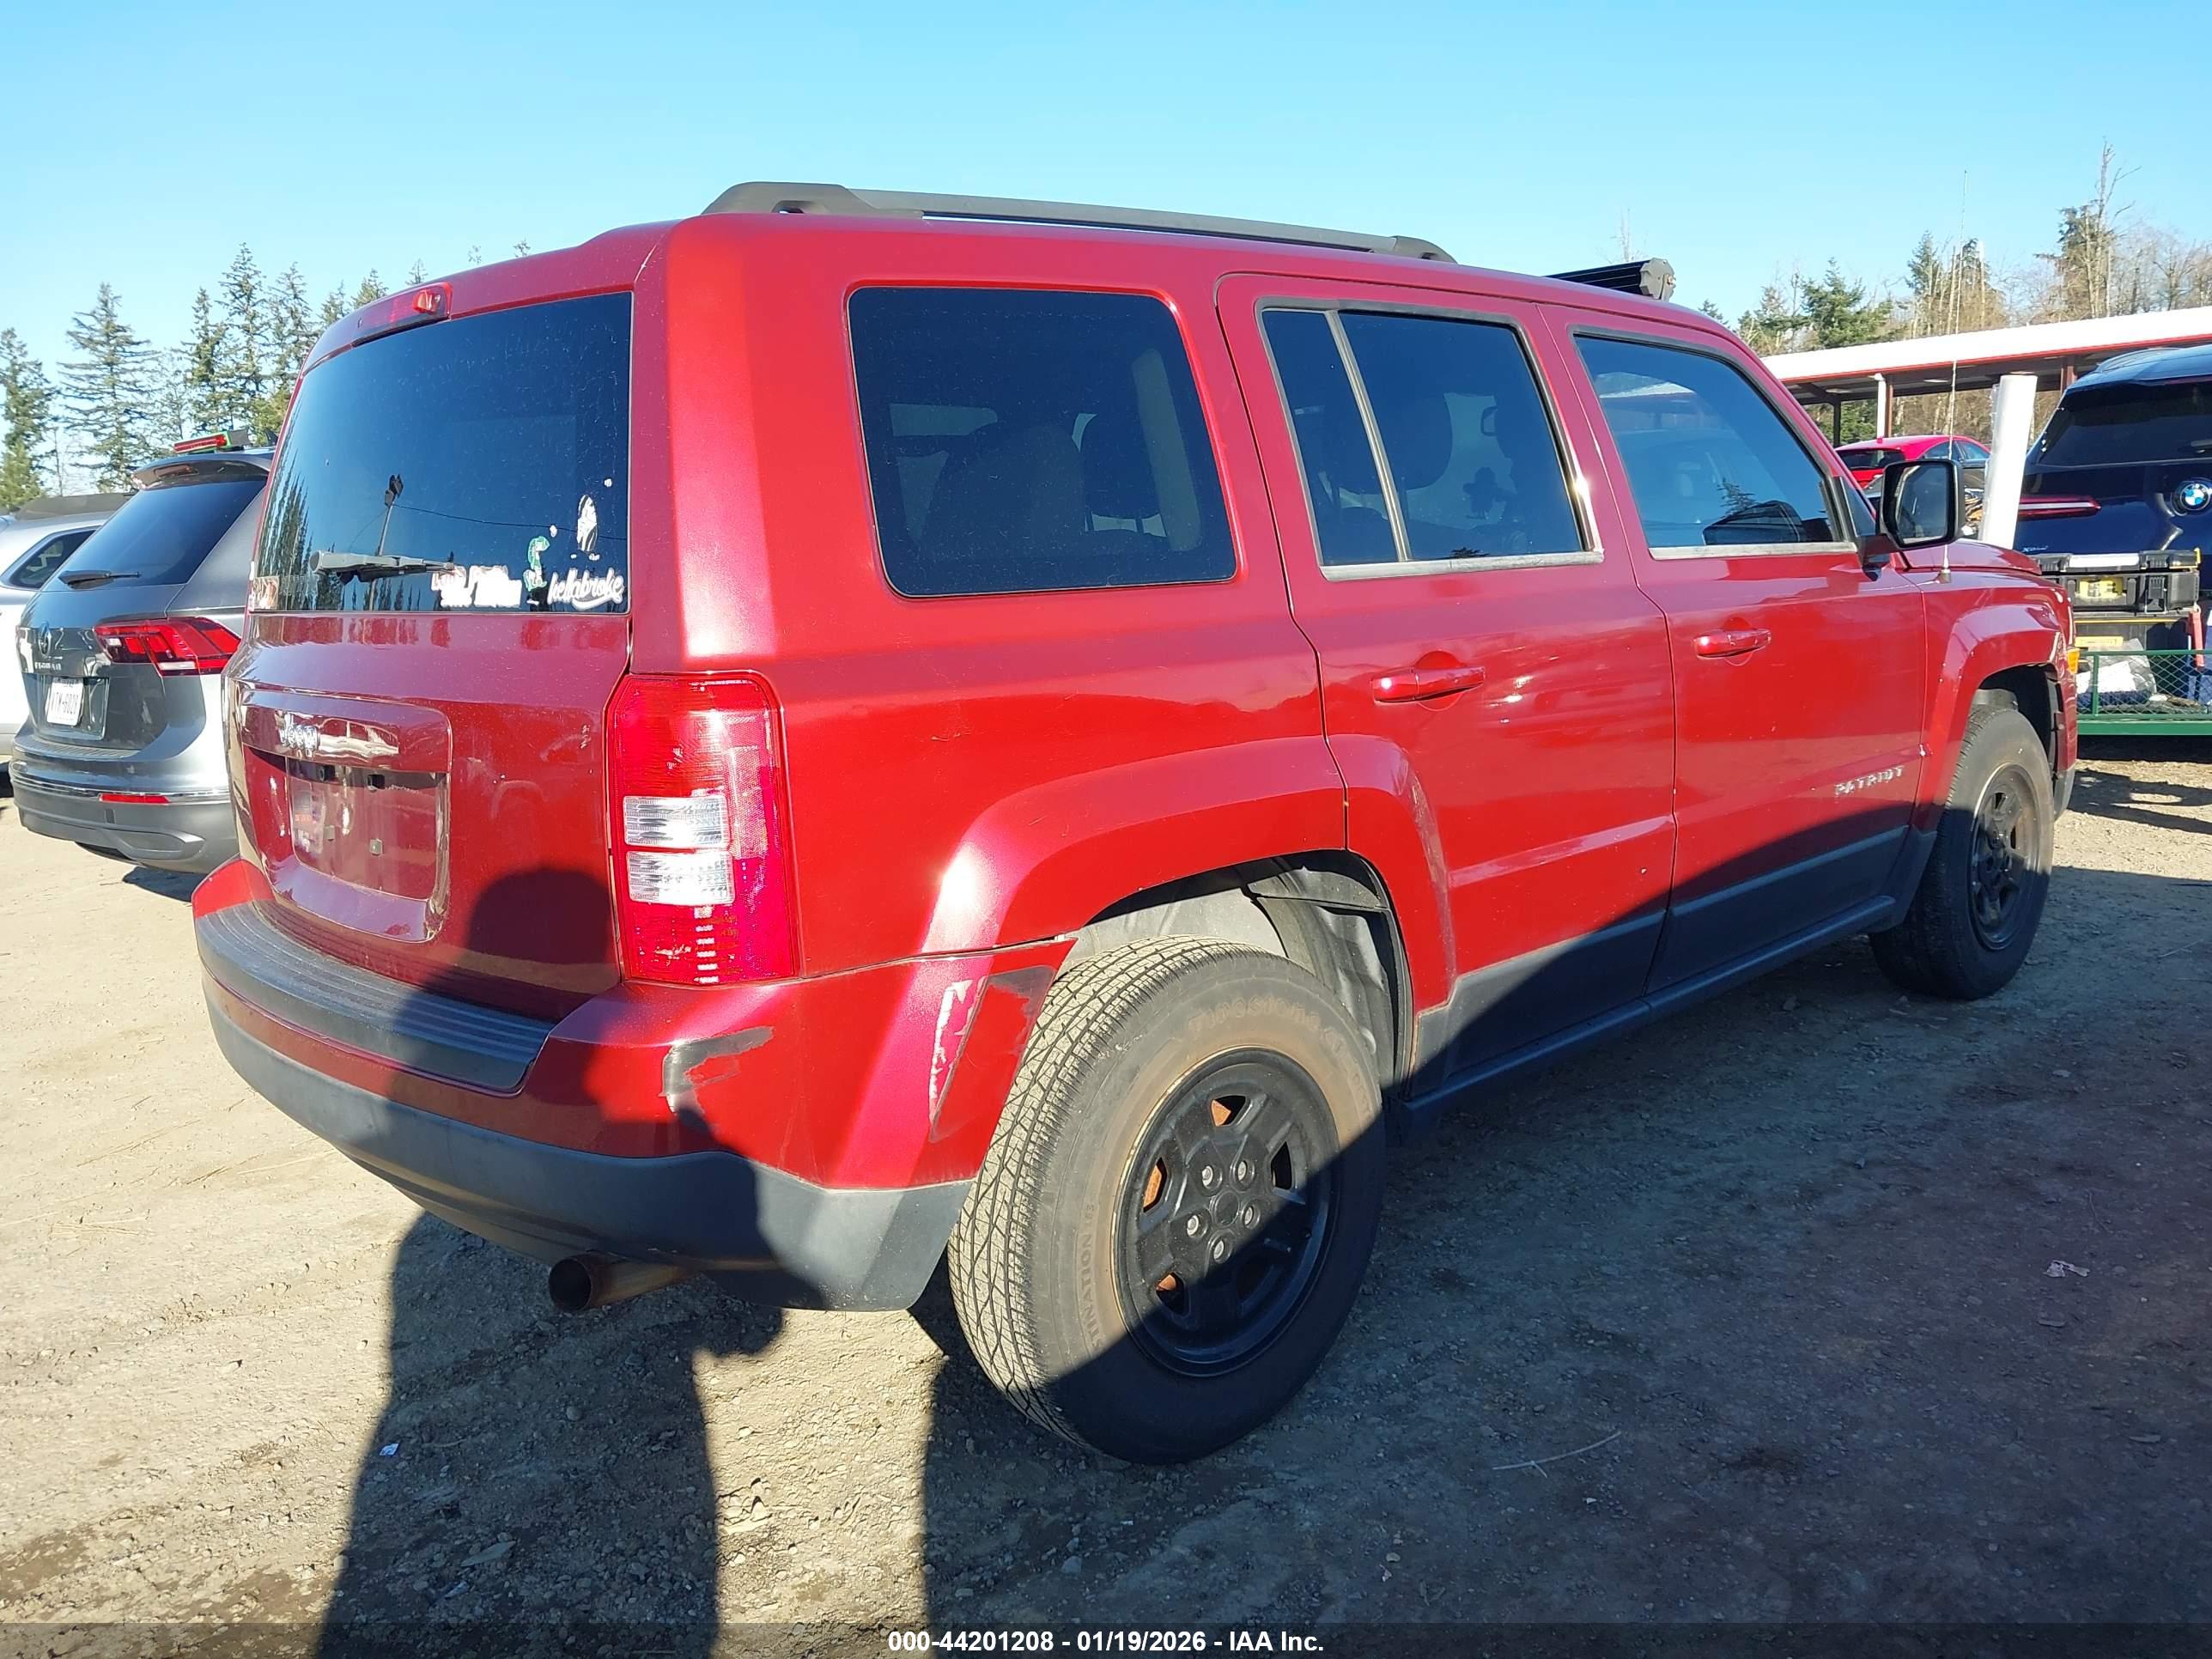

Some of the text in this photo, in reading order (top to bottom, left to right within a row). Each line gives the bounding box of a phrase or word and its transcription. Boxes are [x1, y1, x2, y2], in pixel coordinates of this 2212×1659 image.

[547, 568, 625, 609] hellabroke
[278, 714, 318, 758] Jeep
[1834, 765, 1905, 796] PATRIOT
